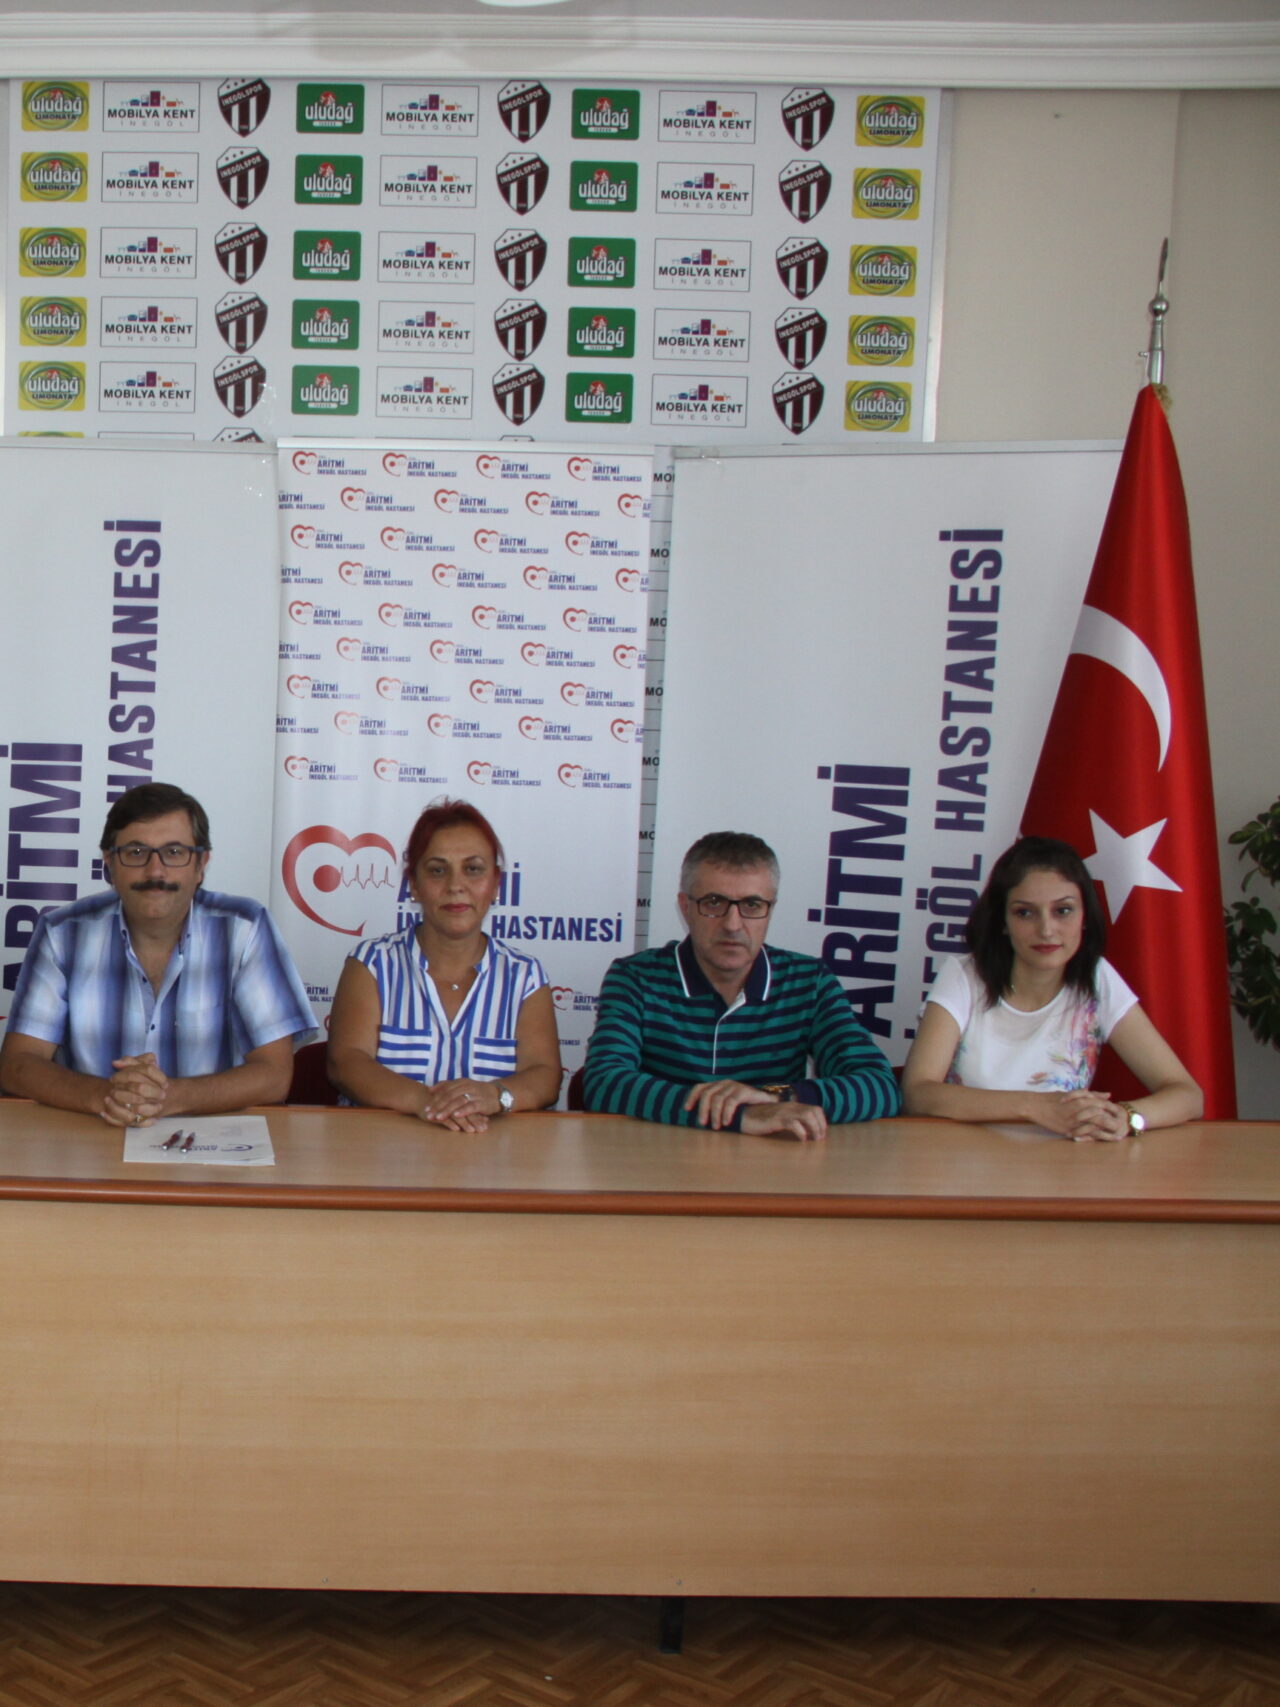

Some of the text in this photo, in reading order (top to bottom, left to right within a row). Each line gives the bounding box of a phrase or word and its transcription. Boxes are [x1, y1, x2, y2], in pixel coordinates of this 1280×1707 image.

[30, 96, 82, 114] uludağ
[164, 109, 196, 118] KENT
[305, 102, 354, 123] uludağ
[442, 113, 474, 122] KENT
[581, 108, 629, 130] uludağ
[719, 119, 752, 129] KENT
[866, 112, 918, 130] uludağ
[29, 167, 81, 185] uludağ
[163, 180, 194, 189] KENT
[304, 173, 352, 194] uludağ
[440, 184, 473, 194] KENT
[579, 180, 627, 202] uludağ
[717, 191, 749, 201] KENT
[862, 184, 914, 202] uludağ
[28, 243, 80, 261] uludağ
[161, 255, 192, 264] KENT
[302, 249, 351, 270] uludağ
[439, 260, 471, 270] KENT
[577, 256, 625, 278] uludağ
[714, 268, 747, 278] KENT
[858, 262, 910, 280] uludağ
[28, 312, 80, 330] uludağ
[161, 324, 193, 334] KENT
[300, 318, 349, 339] uludağ
[439, 330, 471, 339] KENT
[576, 327, 625, 348] uludağ
[714, 338, 746, 348] KENT
[857, 332, 909, 350] uludağ
[27, 376, 79, 394] uludağ
[160, 390, 192, 399] KENT
[300, 384, 349, 405] uludağ
[437, 395, 469, 405] KENT
[574, 392, 622, 413] uludağ
[711, 403, 744, 413] KENT
[854, 397, 906, 415] uludağ
[935, 529, 1004, 832] HASTANESİ
[491, 912, 622, 942] HASTANESİ
